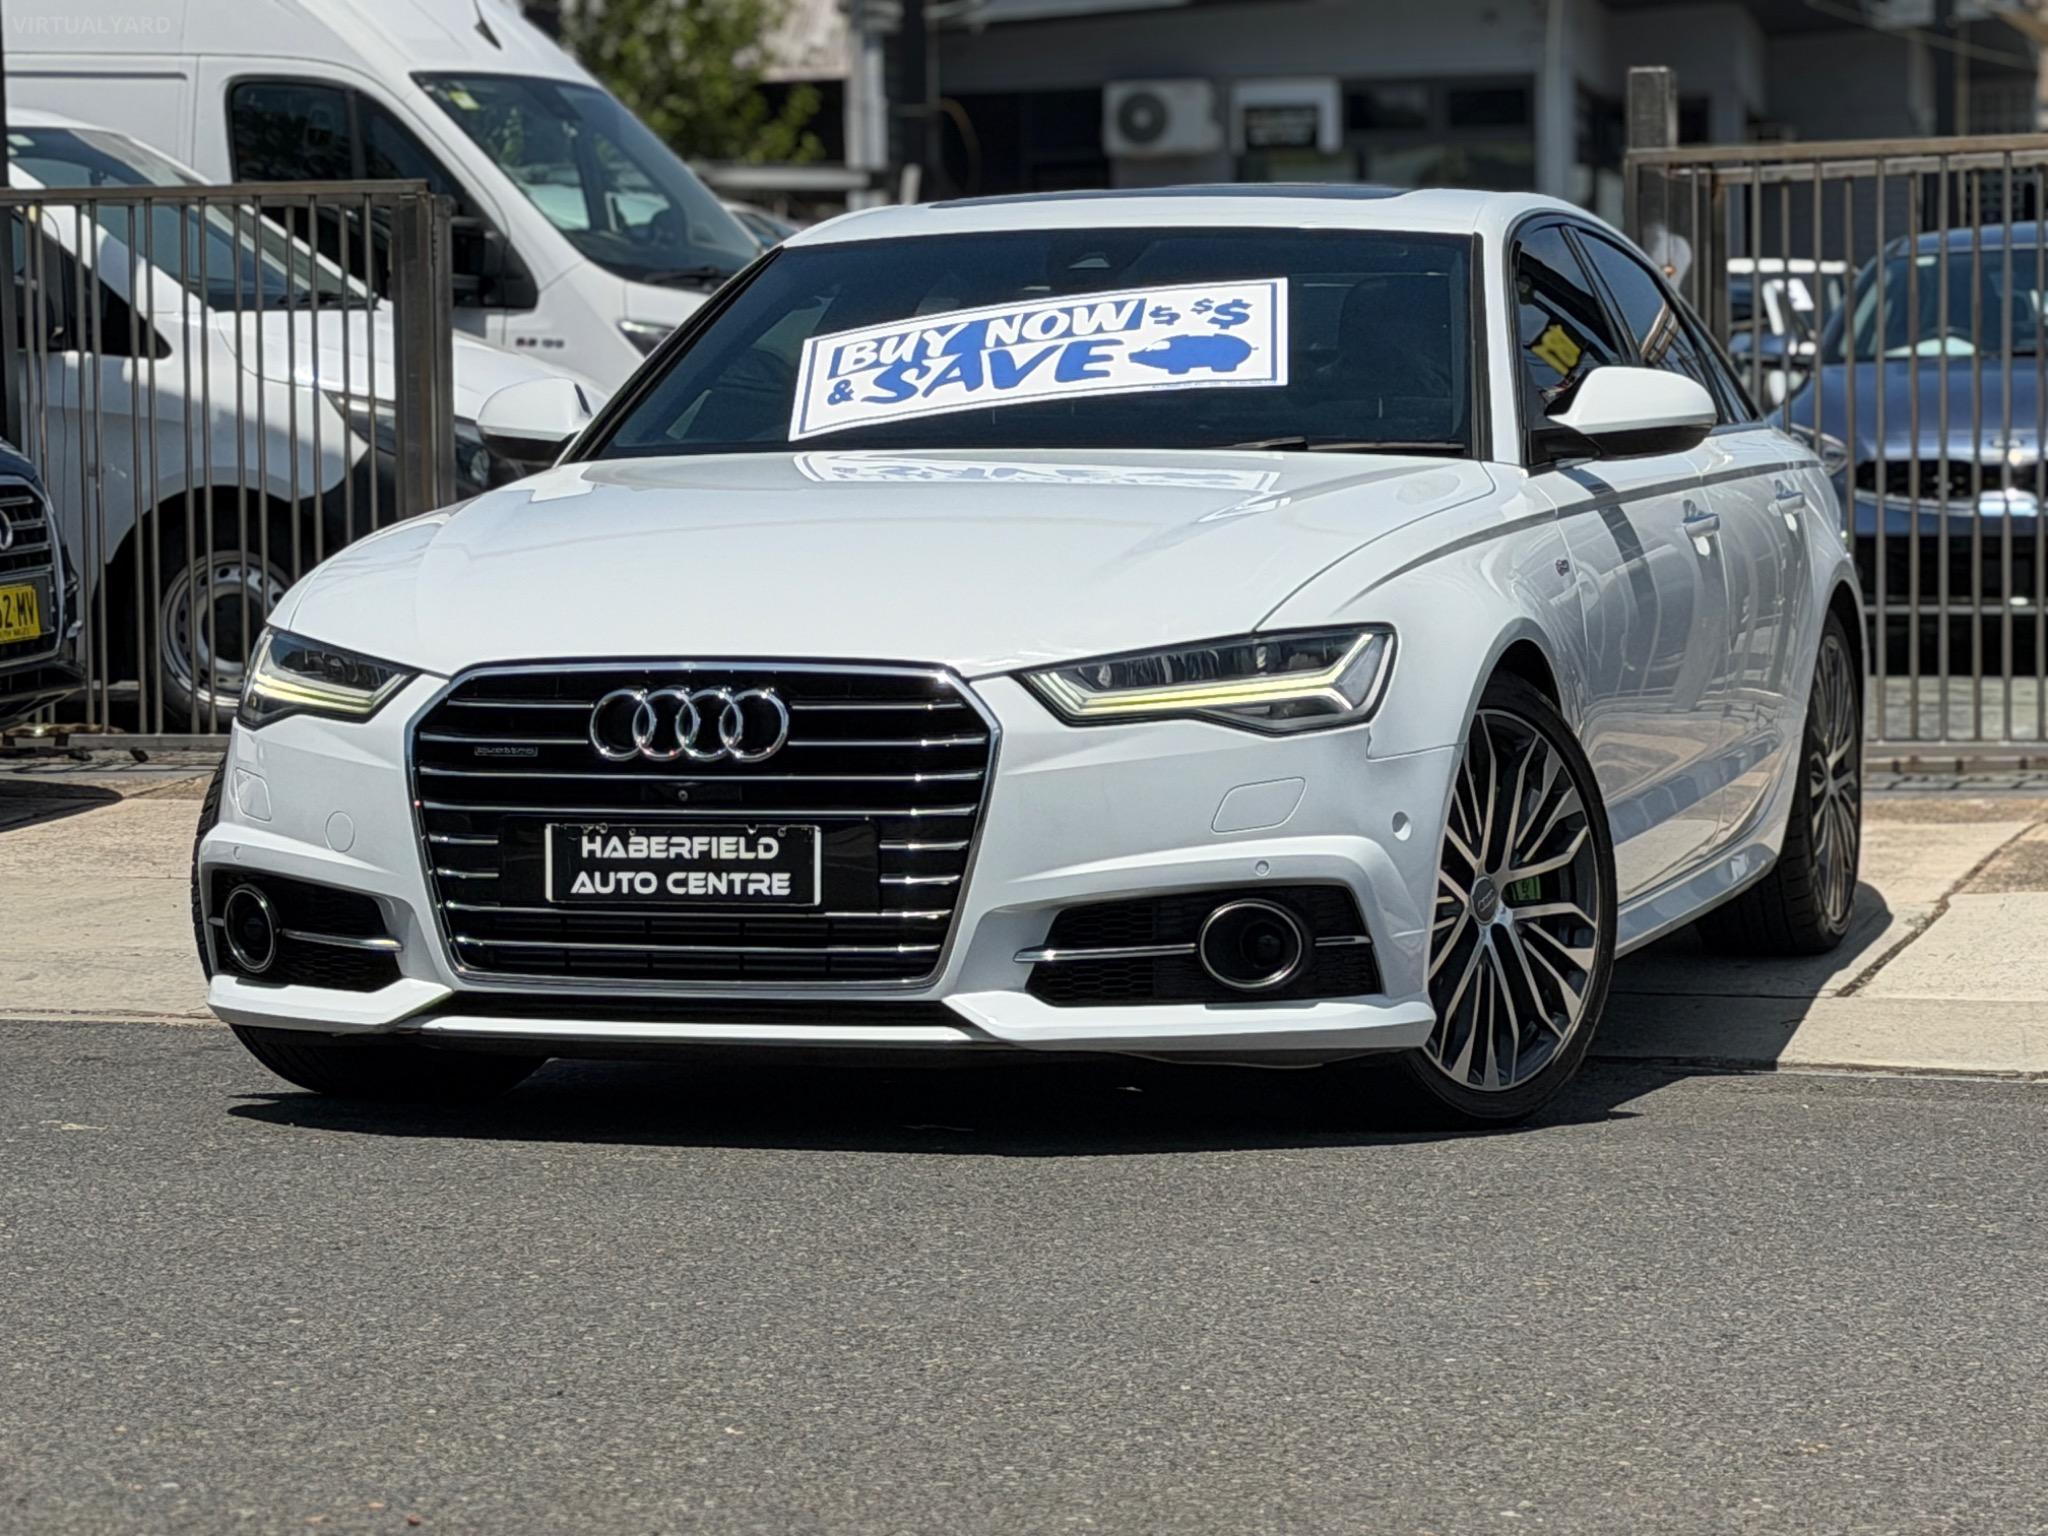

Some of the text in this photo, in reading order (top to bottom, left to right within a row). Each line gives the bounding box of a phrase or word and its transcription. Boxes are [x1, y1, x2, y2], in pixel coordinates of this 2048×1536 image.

[837, 300, 1140, 375] BUY NOW
[827, 338, 1125, 406] & SAVE
[581, 836, 779, 860] HABERFIELD
[570, 871, 791, 896] AUTO CENTRE
